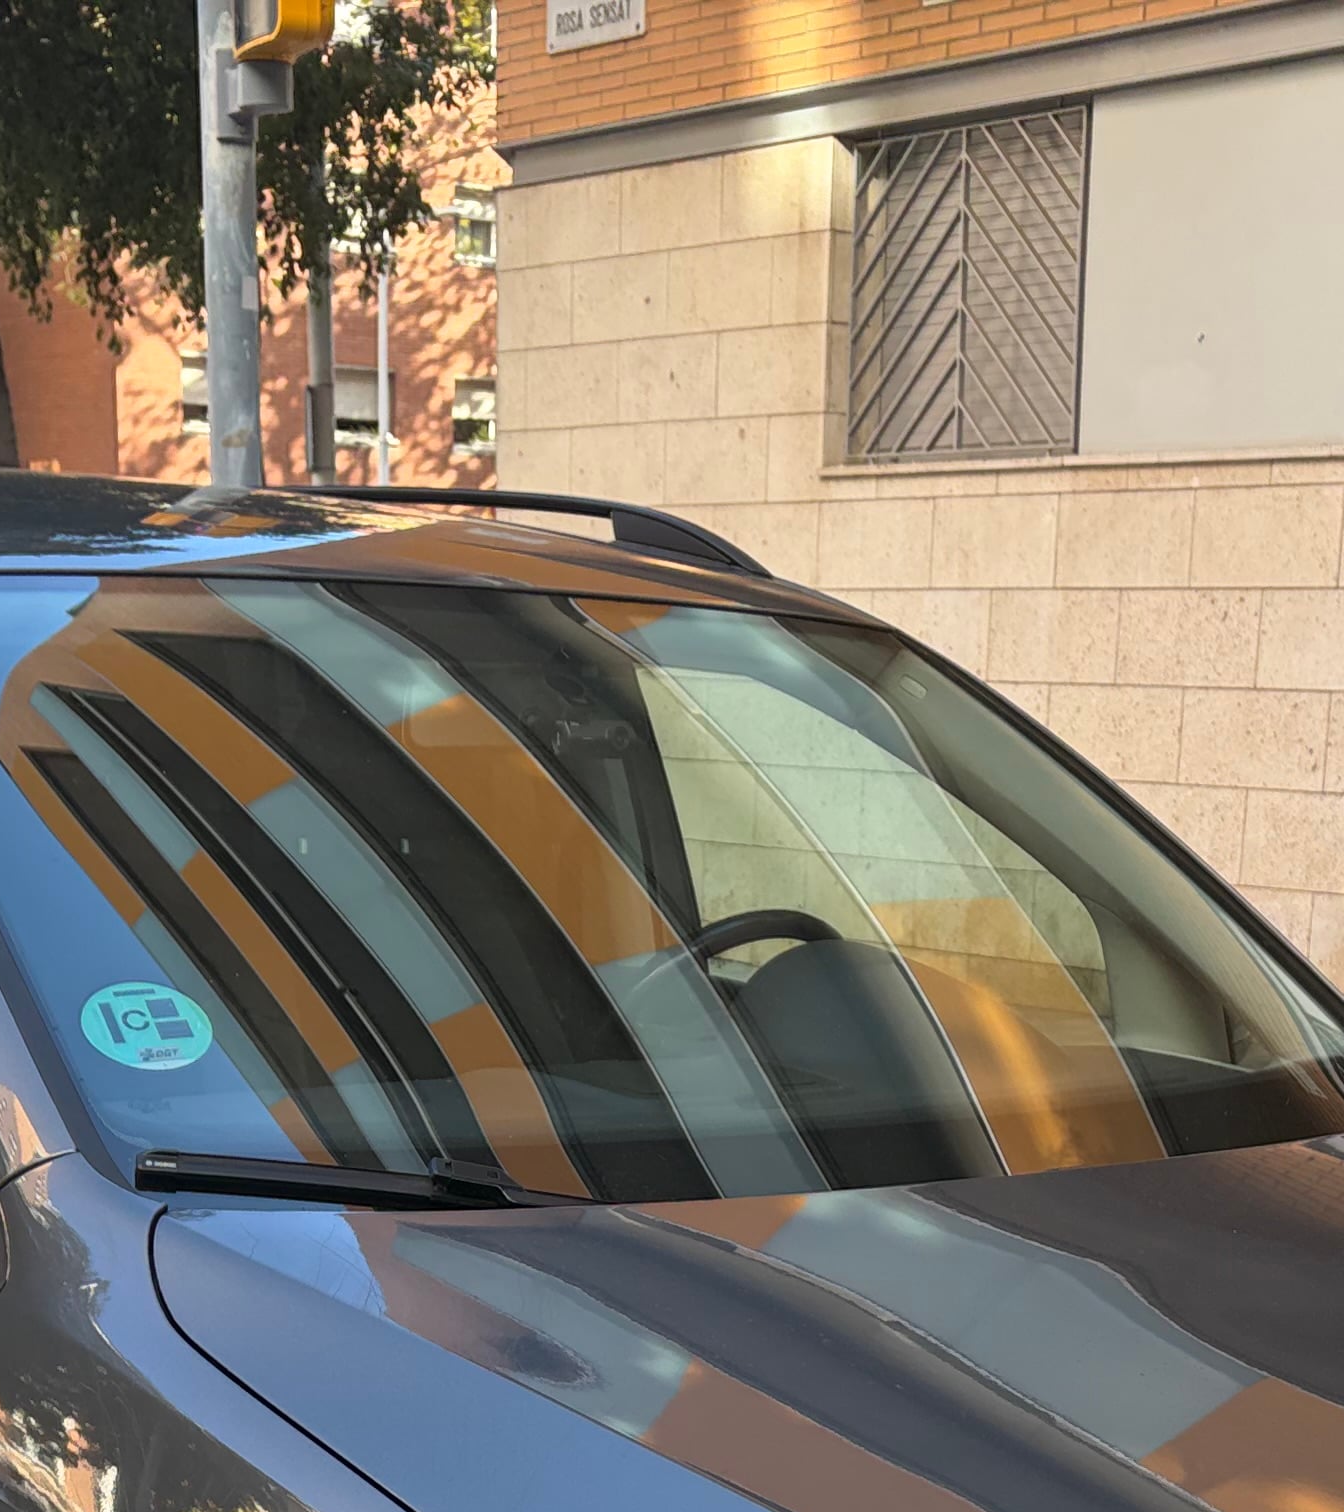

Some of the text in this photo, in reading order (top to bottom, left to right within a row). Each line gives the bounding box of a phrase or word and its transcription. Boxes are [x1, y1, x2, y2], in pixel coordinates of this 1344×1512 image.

[555, 0, 632, 36] ROSA SENSAT
[122, 1010, 150, 1031] C
